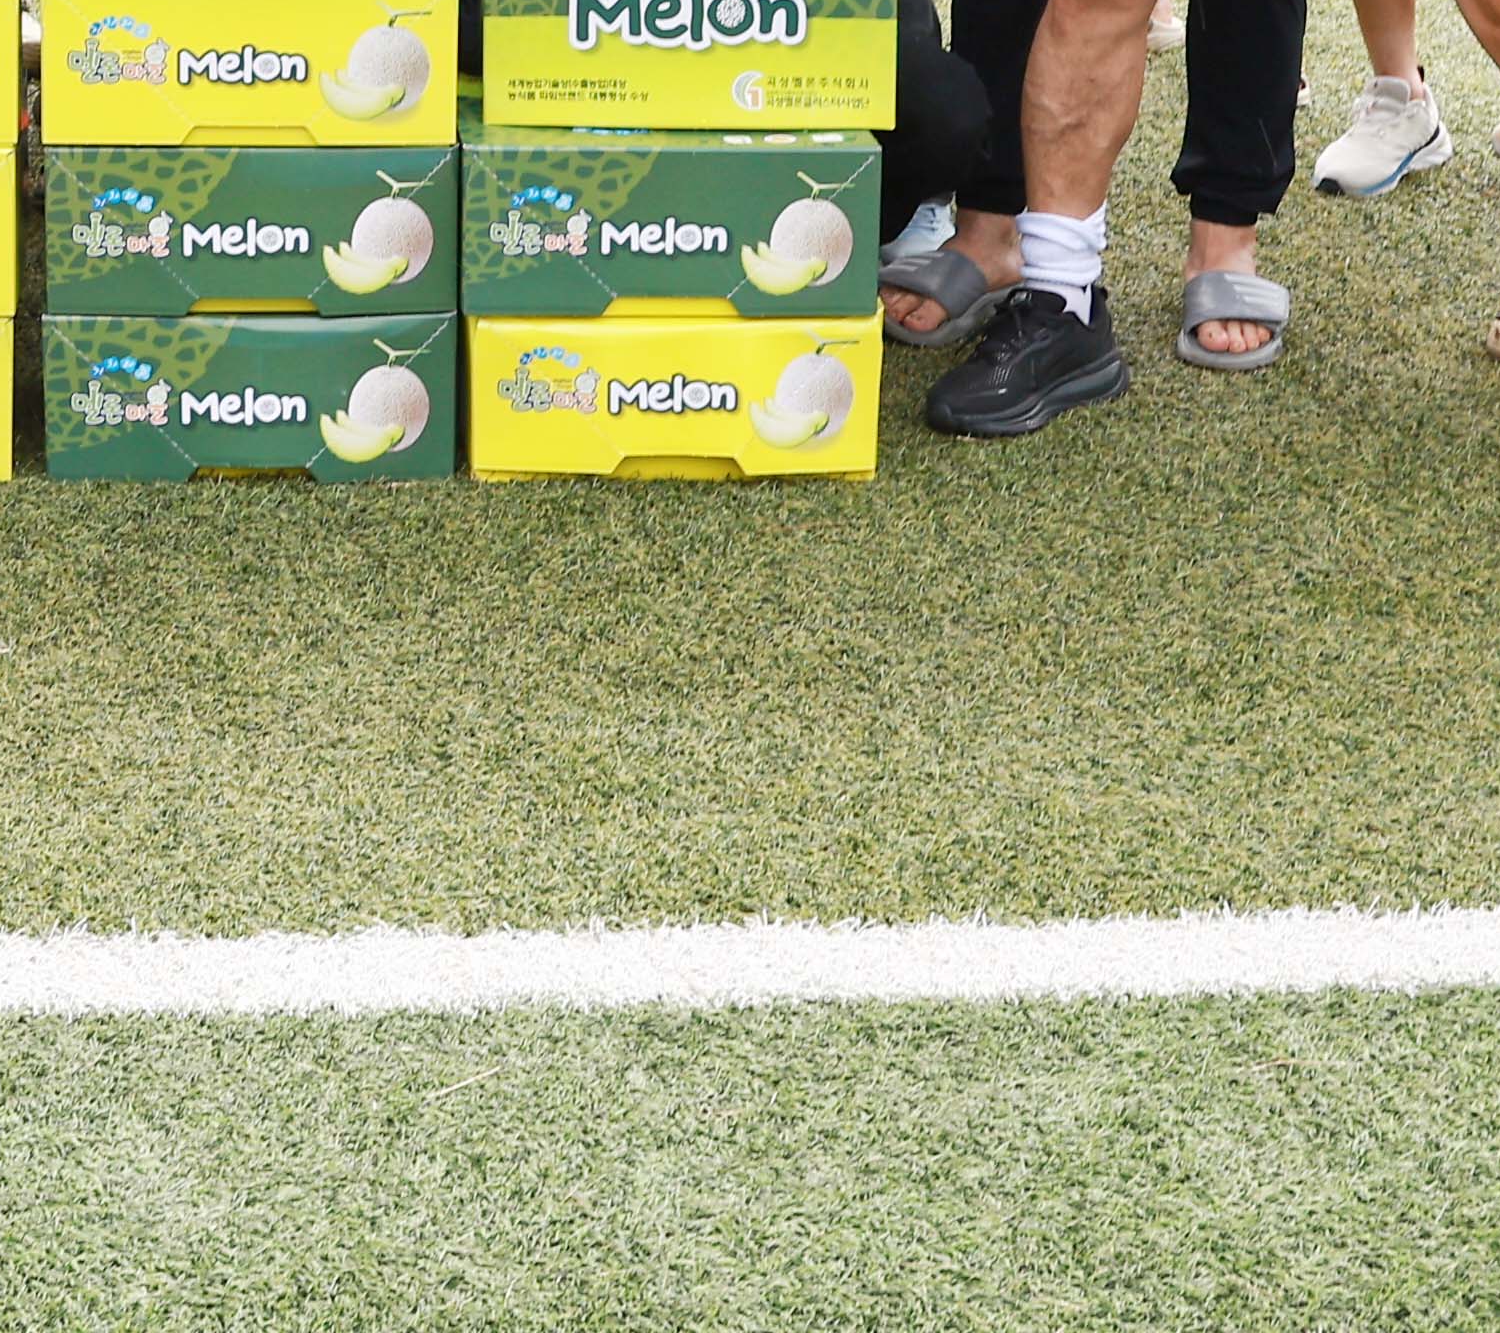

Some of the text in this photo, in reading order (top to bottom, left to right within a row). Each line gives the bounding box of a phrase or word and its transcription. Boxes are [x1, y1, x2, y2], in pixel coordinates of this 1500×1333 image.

[179, 45, 308, 84] Melon
[183, 218, 310, 257] Melon
[600, 216, 730, 255] Melon
[181, 387, 308, 425] Melon
[607, 373, 739, 414] Melon
